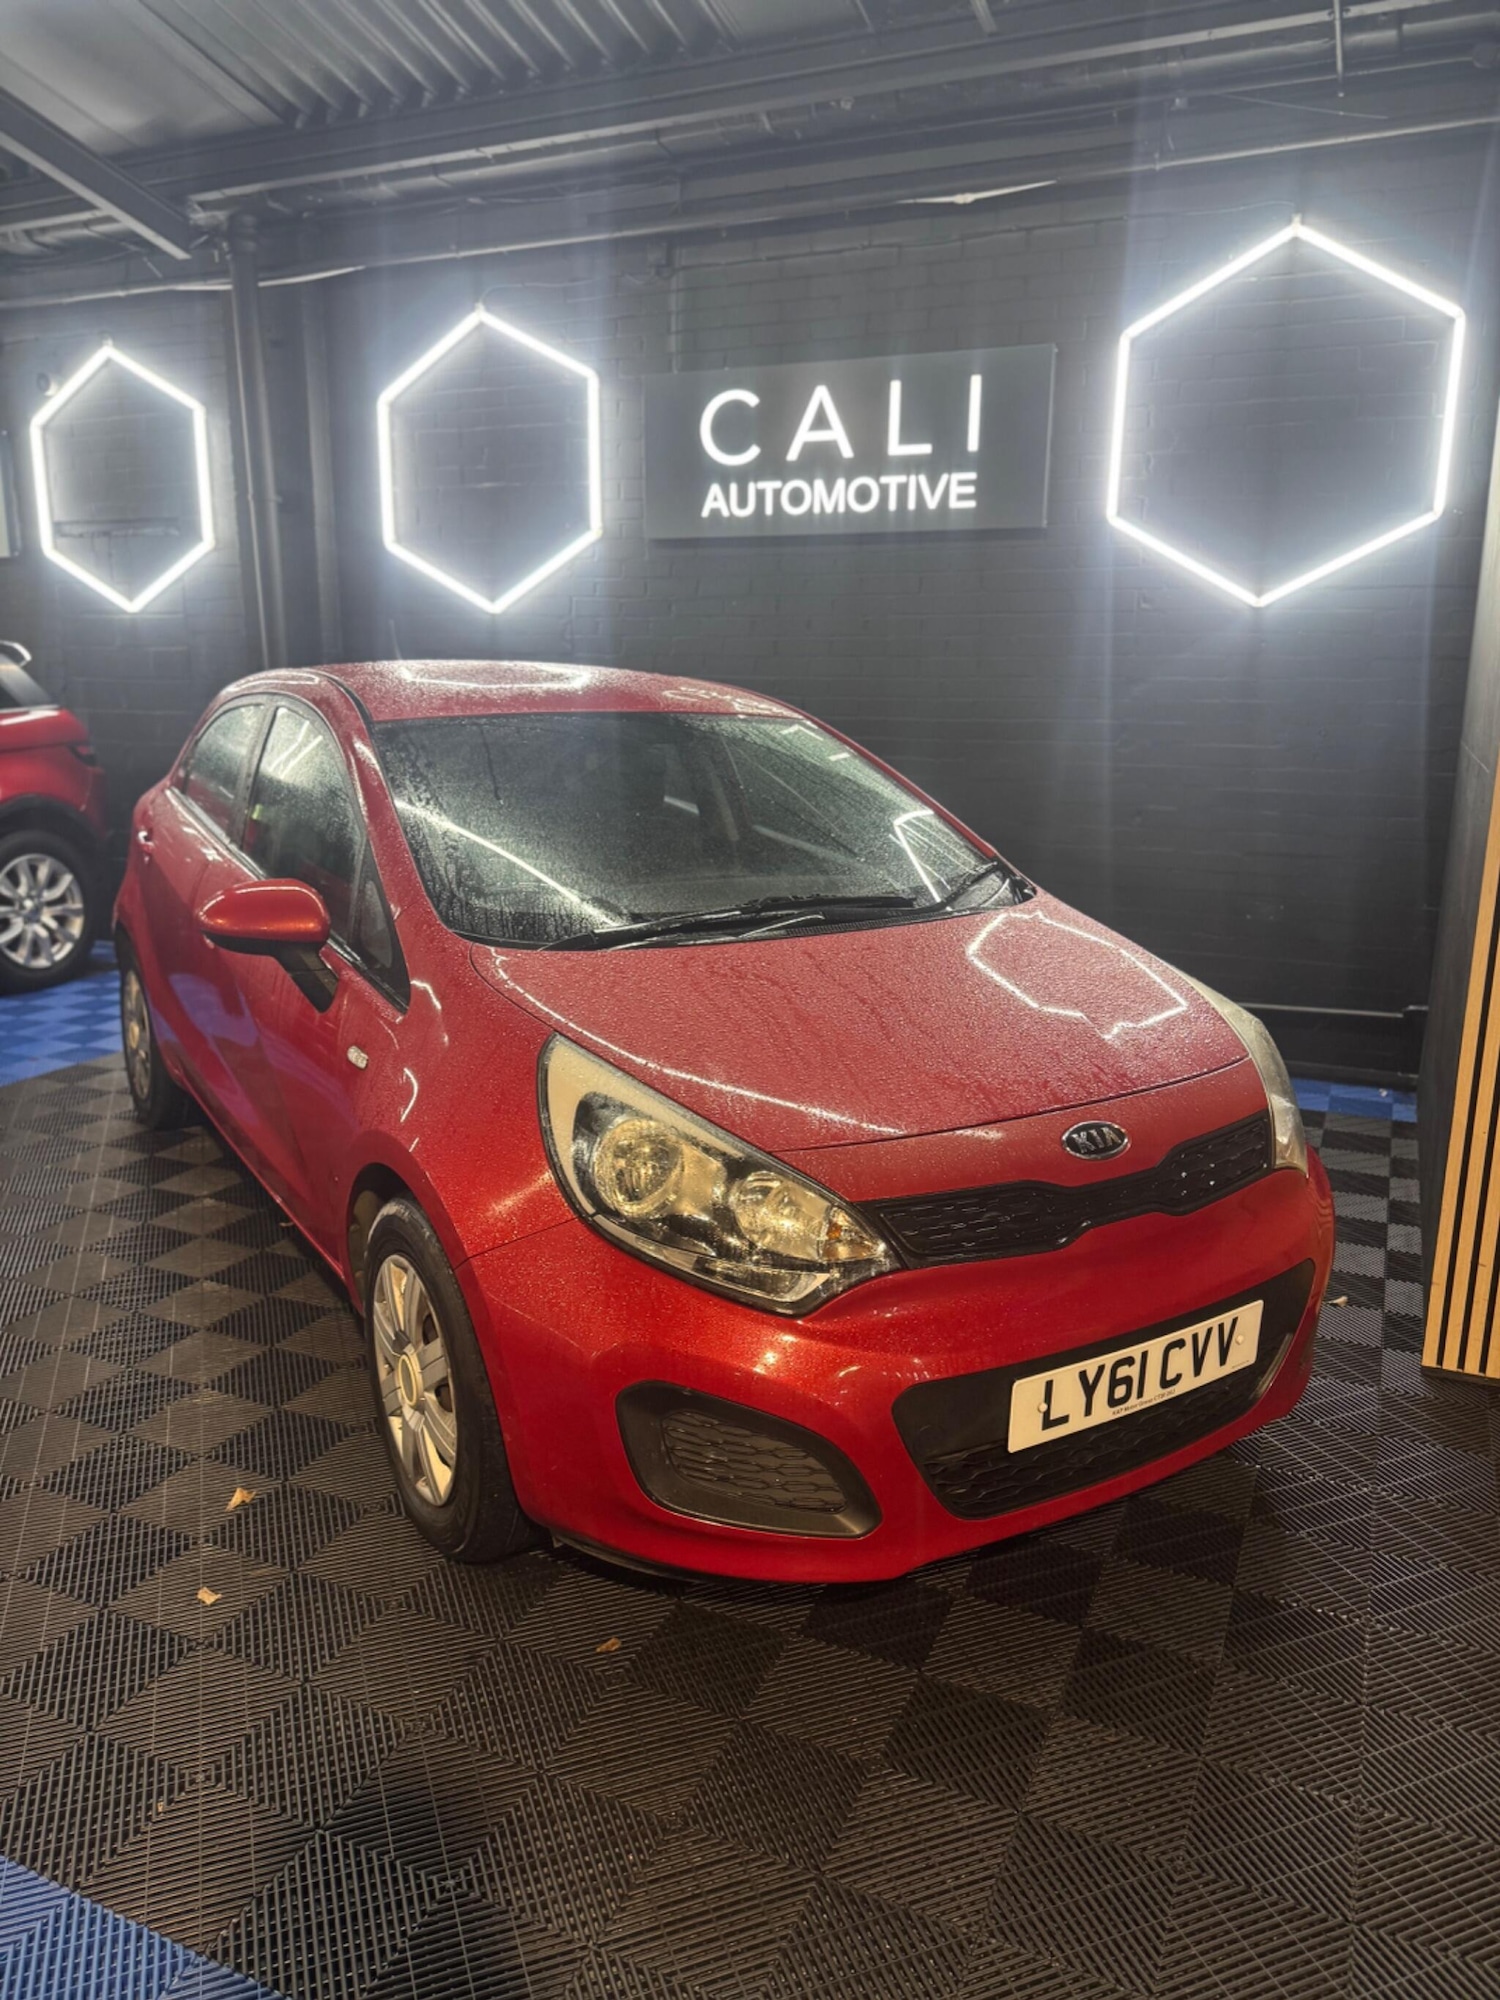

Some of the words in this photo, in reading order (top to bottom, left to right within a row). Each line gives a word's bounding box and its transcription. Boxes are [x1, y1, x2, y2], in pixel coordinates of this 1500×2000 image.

[699, 373, 983, 466] CALI
[700, 472, 978, 518] AUTOMOTIVE
[1071, 1126, 1122, 1153] KIA
[1041, 1350, 1149, 1431] LY61
[1159, 1316, 1239, 1390] CVV
